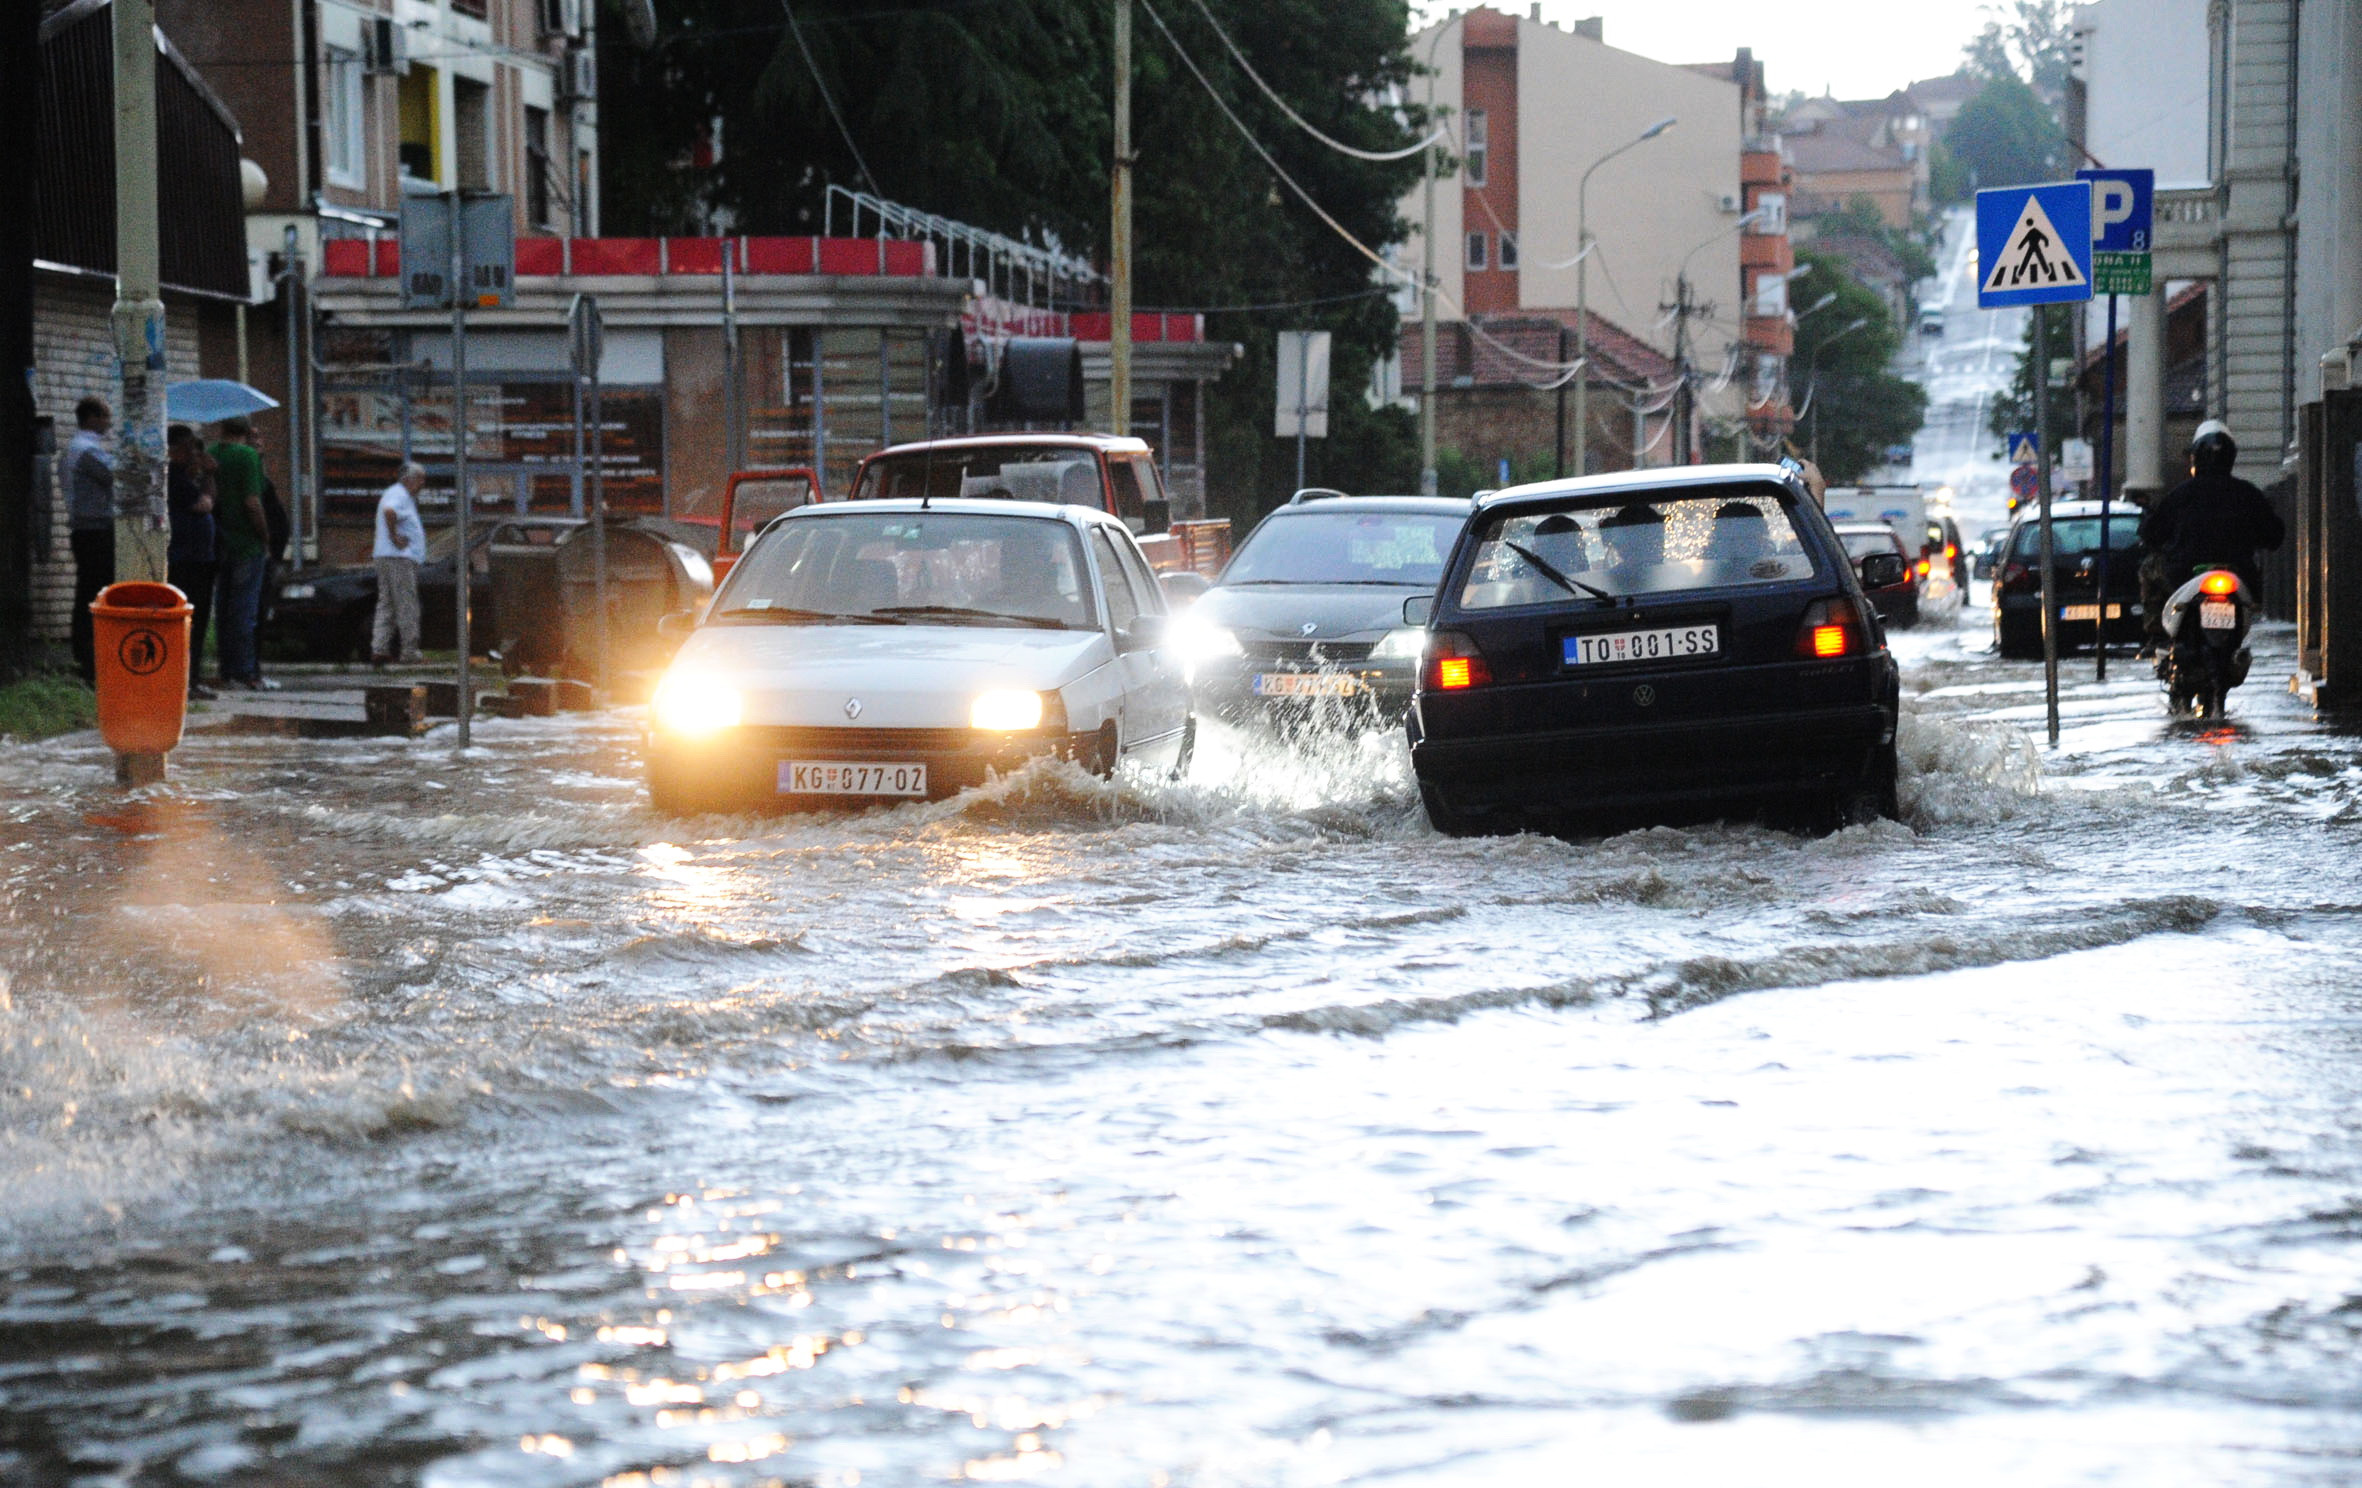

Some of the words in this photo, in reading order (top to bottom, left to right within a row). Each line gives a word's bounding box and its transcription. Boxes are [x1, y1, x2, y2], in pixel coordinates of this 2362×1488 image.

[2092, 180, 2134, 241] P
[2133, 230, 2145, 250] 8
[1582, 639, 1610, 663] TO
[794, 766, 823, 789] KG
